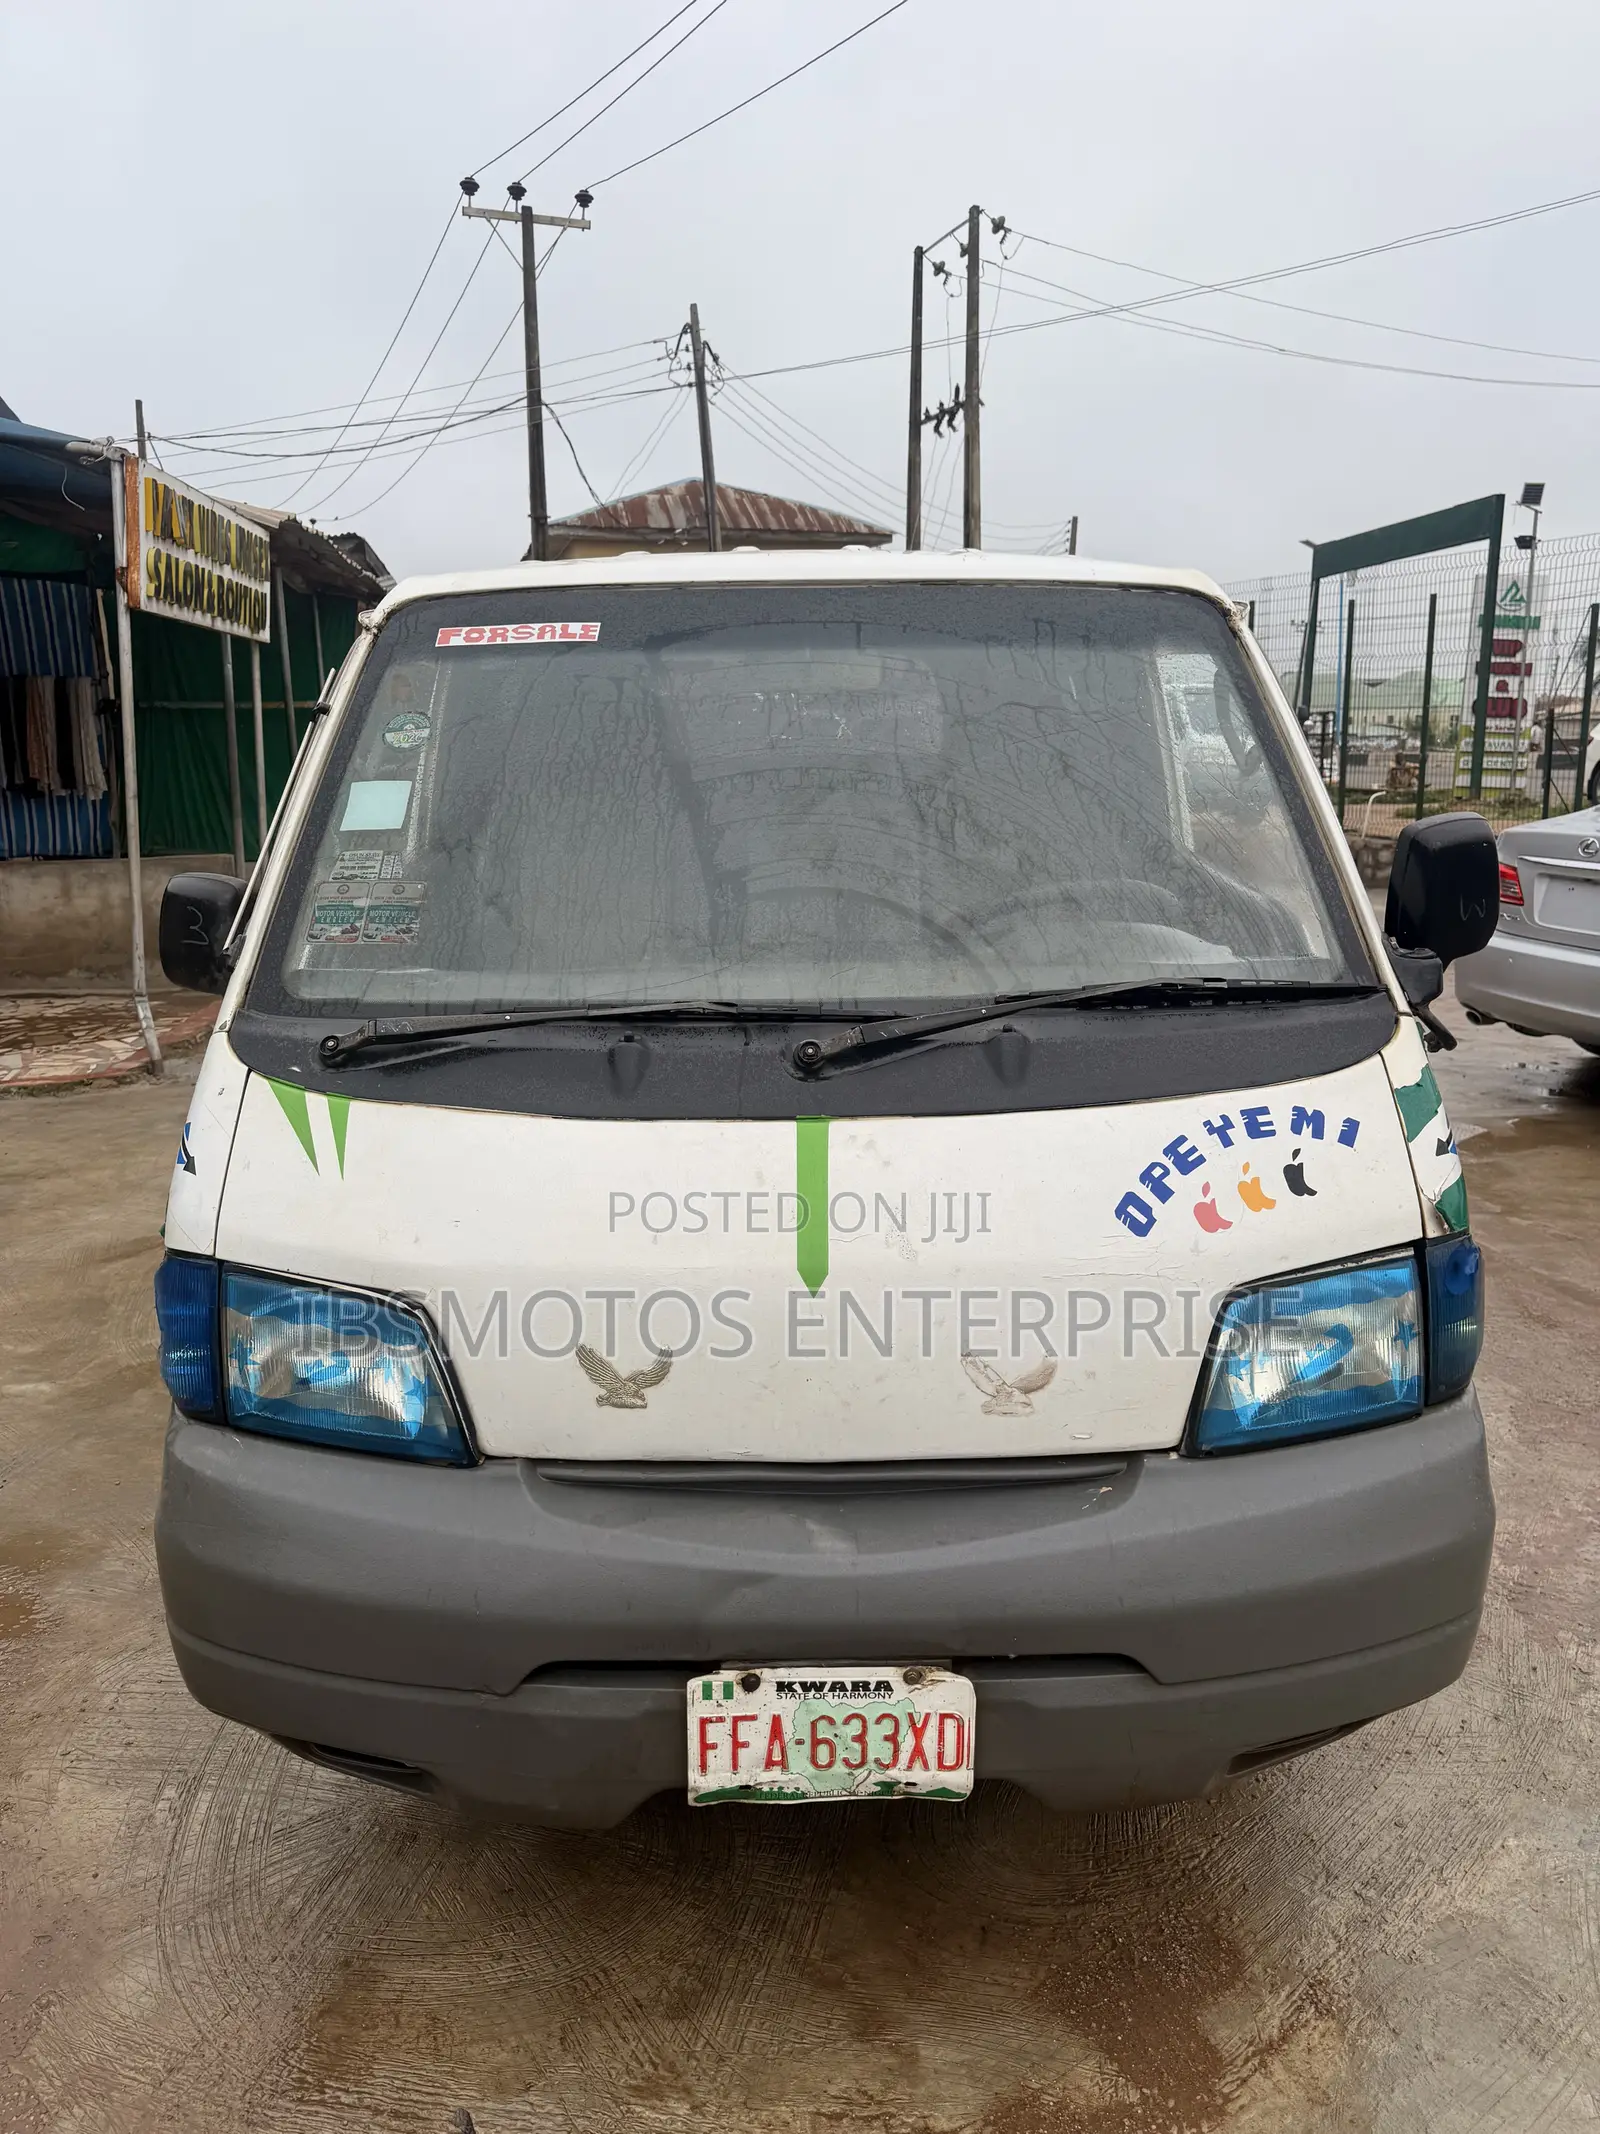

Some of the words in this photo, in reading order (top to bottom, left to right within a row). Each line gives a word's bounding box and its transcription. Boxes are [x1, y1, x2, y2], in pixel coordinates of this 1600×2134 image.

[1472, 697, 1528, 719] LUB
[1114, 1105, 1360, 1237] OPEYEMI
[775, 1680, 894, 1693] KWARA
[776, 1692, 810, 1700] STATE
[811, 1692, 829, 1700] OF
[836, 1692, 894, 1700] HARMONY
[698, 1712, 965, 1774] FFA-633XD
